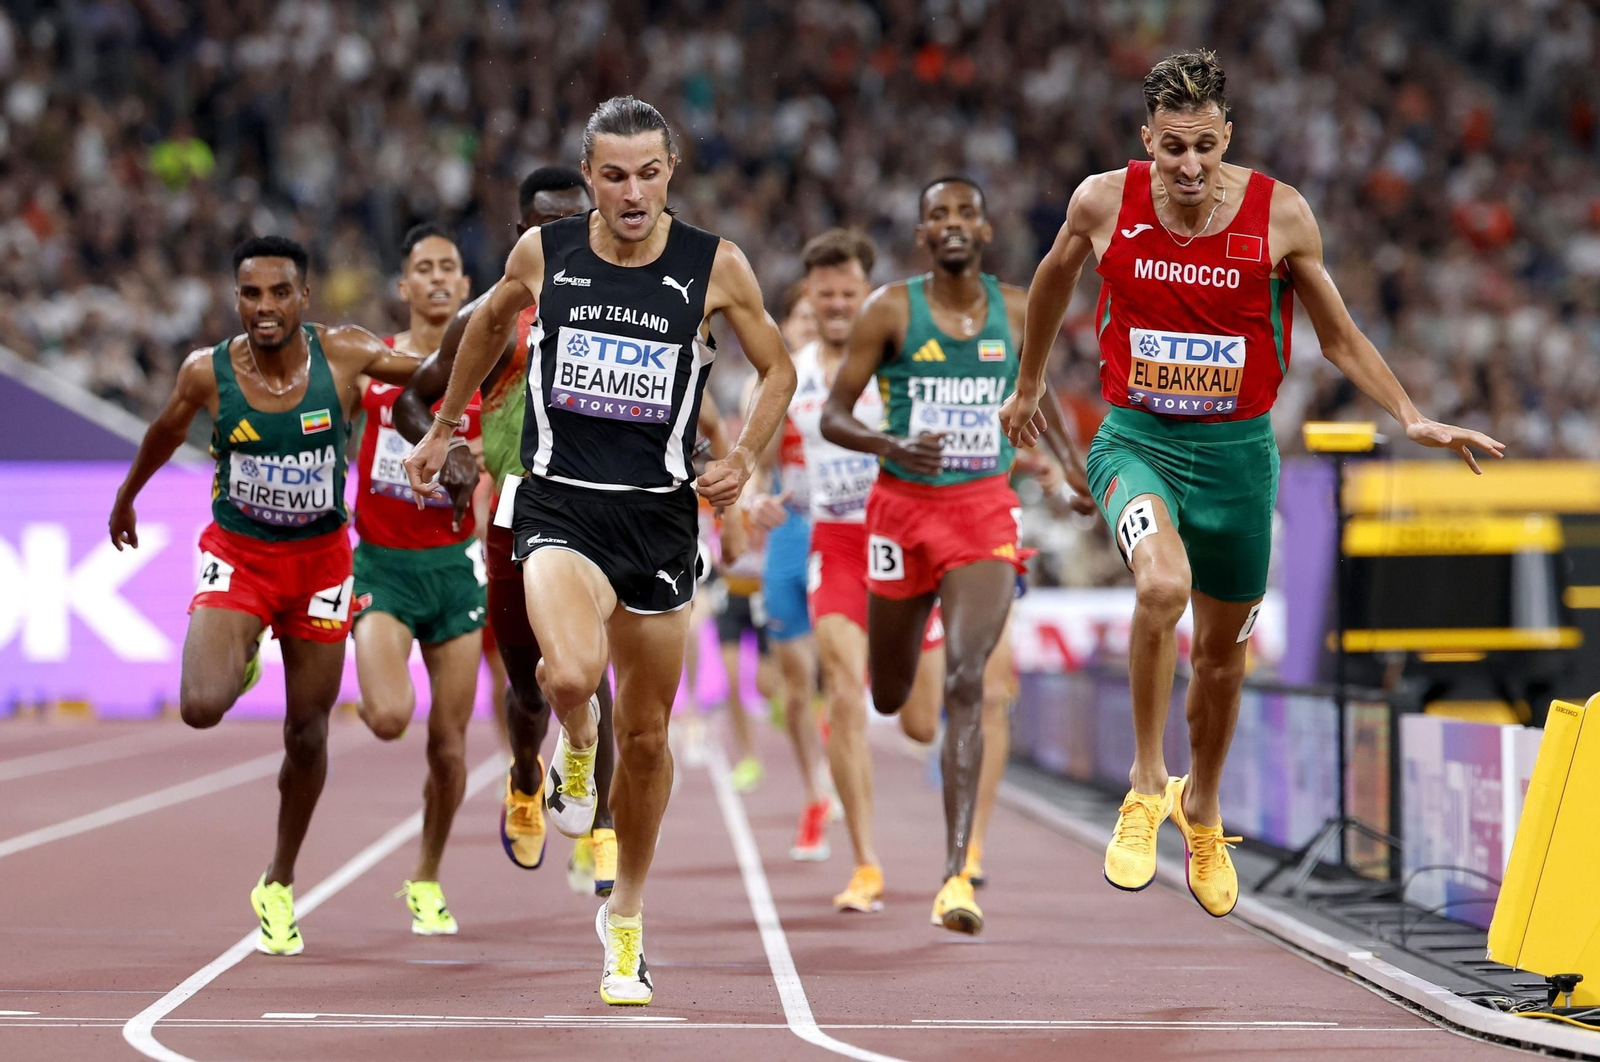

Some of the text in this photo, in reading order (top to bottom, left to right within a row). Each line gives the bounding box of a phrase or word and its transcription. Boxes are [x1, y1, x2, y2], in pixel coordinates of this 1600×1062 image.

[1134, 258, 1240, 289] MOROCCO
[569, 304, 669, 334] NEW ZEALAND
[591, 336, 669, 369] TDK
[1161, 336, 1239, 364] TDK
[560, 362, 668, 400] BEAMISH
[1134, 361, 1239, 393] EL BAKKALI
[941, 407, 994, 428] TDK
[260, 463, 325, 485] TDK
[236, 480, 326, 509] FIREWU
[1121, 507, 1150, 548] 15
[203, 552, 219, 585] 4
[872, 544, 896, 571] 13
[1555, 706, 1579, 718] SEIKO
